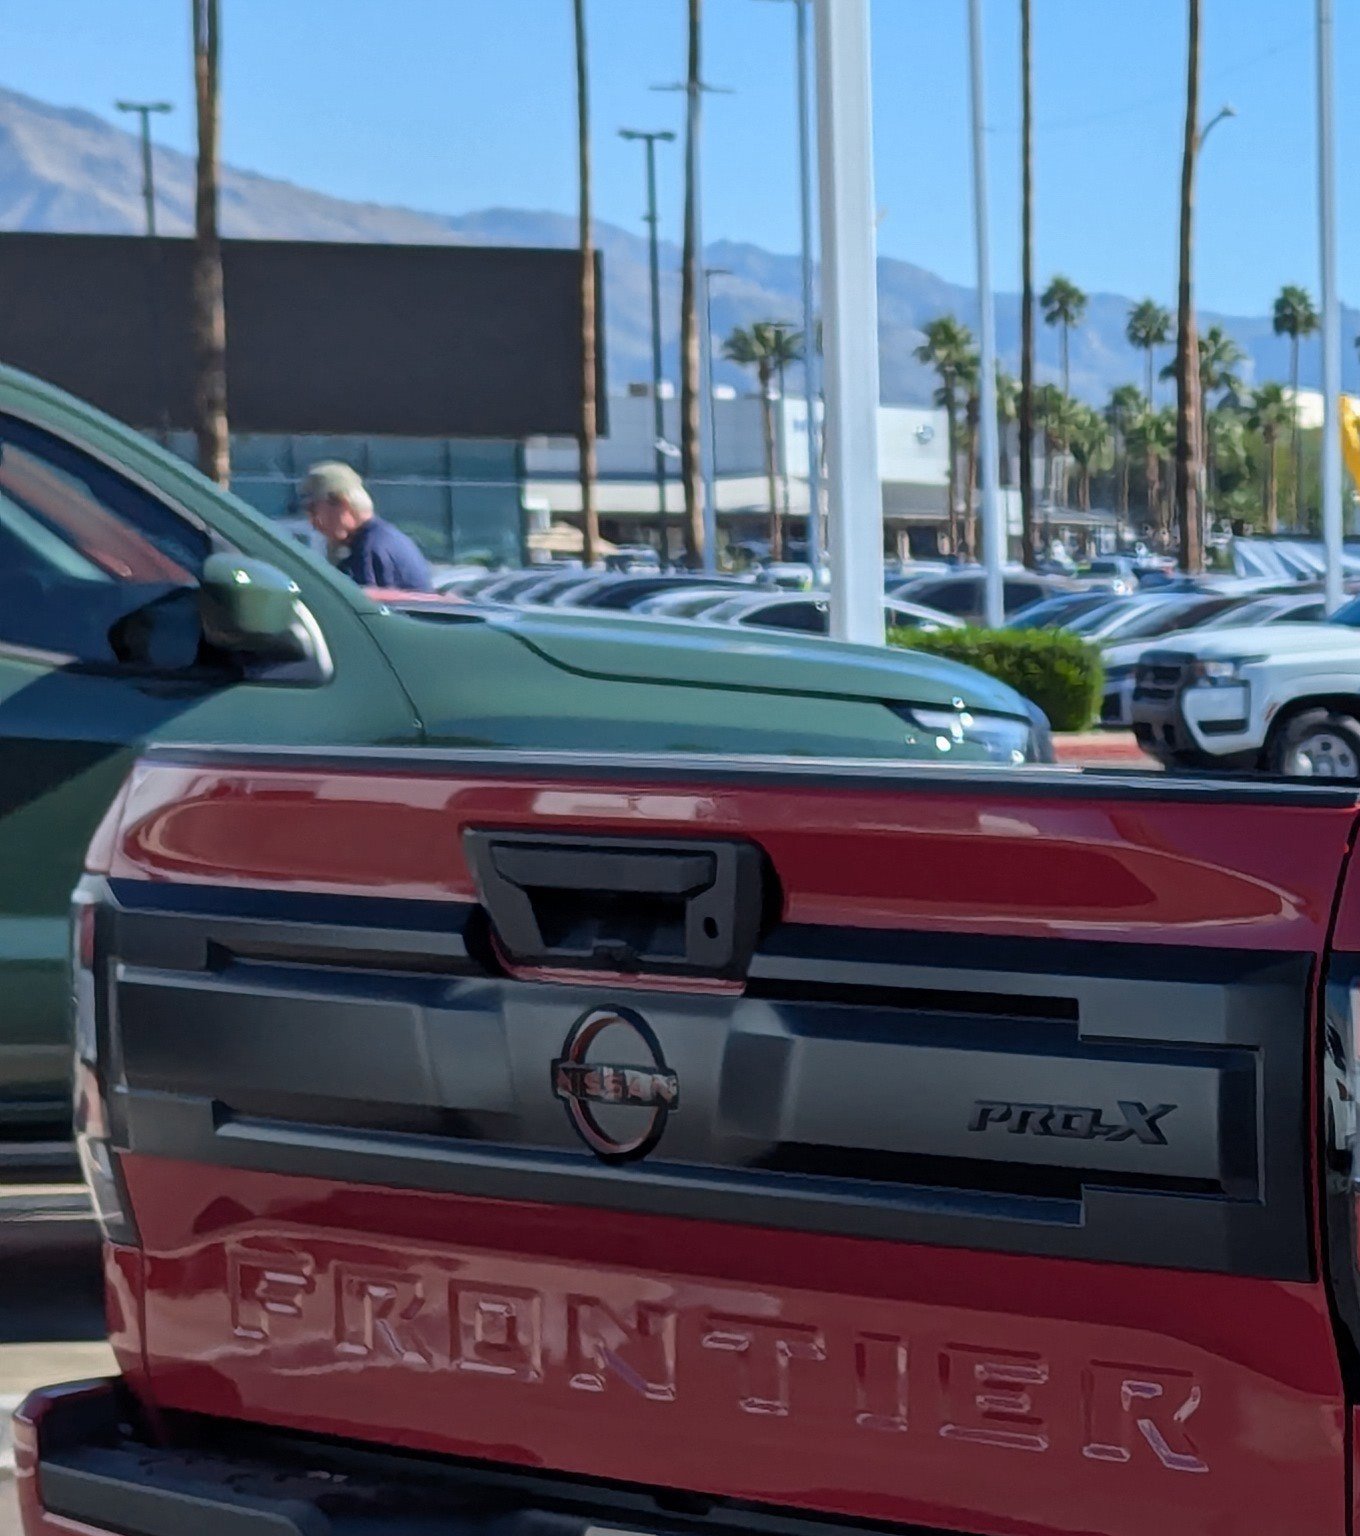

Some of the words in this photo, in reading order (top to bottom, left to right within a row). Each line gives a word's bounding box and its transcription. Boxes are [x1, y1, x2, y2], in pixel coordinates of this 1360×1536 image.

[556, 1064, 679, 1104] NISSAN
[967, 1100, 1178, 1145] PRO-X
[227, 1250, 1210, 1473] FRONTIER
